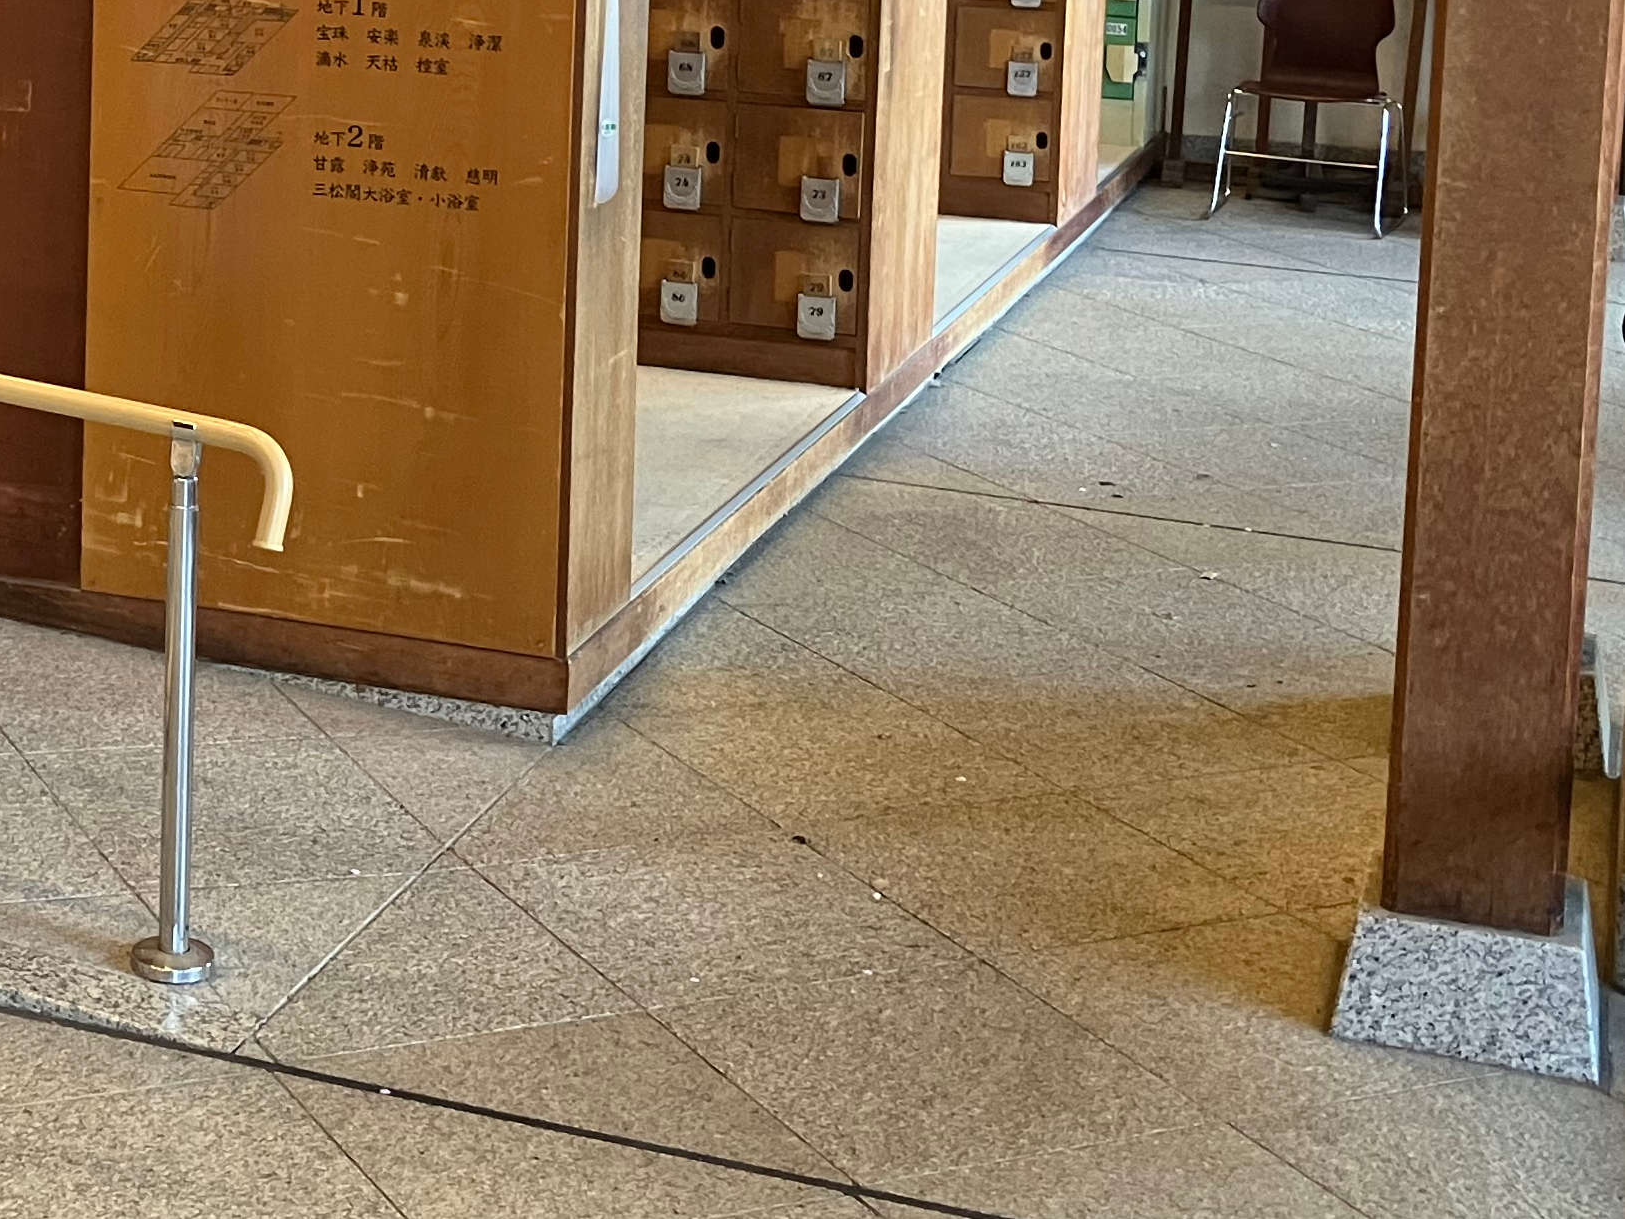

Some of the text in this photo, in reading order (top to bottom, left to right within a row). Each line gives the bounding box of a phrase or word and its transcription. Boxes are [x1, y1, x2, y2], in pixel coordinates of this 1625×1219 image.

[316, 25, 349, 42] 宝珠
[367, 28, 399, 47] 安楽
[417, 57, 449, 75] 控室
[818, 72, 833, 82] 67
[314, 125, 384, 151] 地下2階
[313, 156, 345, 174] 甘露
[812, 190, 826, 200] 73
[808, 306, 824, 317] 79
